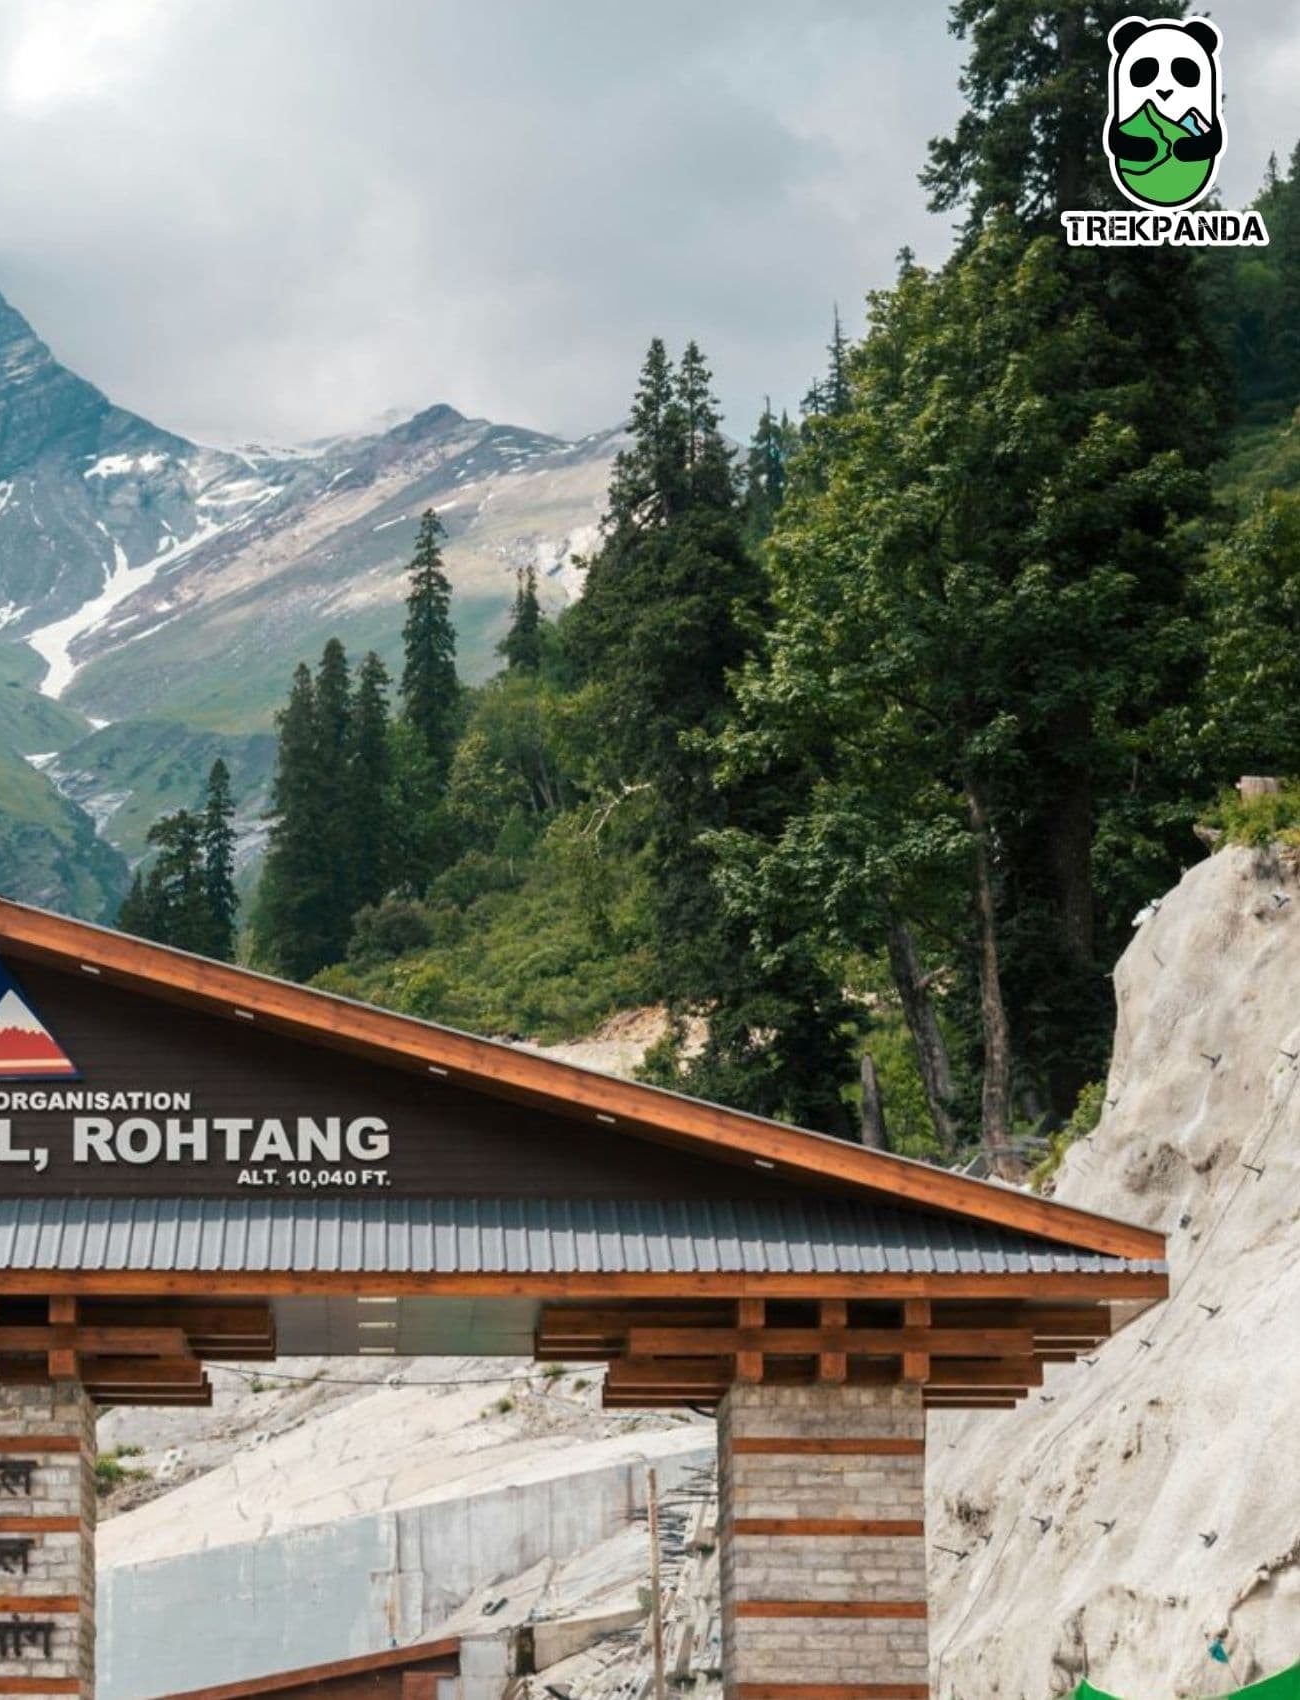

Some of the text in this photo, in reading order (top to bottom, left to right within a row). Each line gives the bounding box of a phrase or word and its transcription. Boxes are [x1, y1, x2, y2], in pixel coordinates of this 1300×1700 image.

[73, 1116, 391, 1162] ROHTANG
[236, 1168, 392, 1188] ALT. 10,040 FT.
